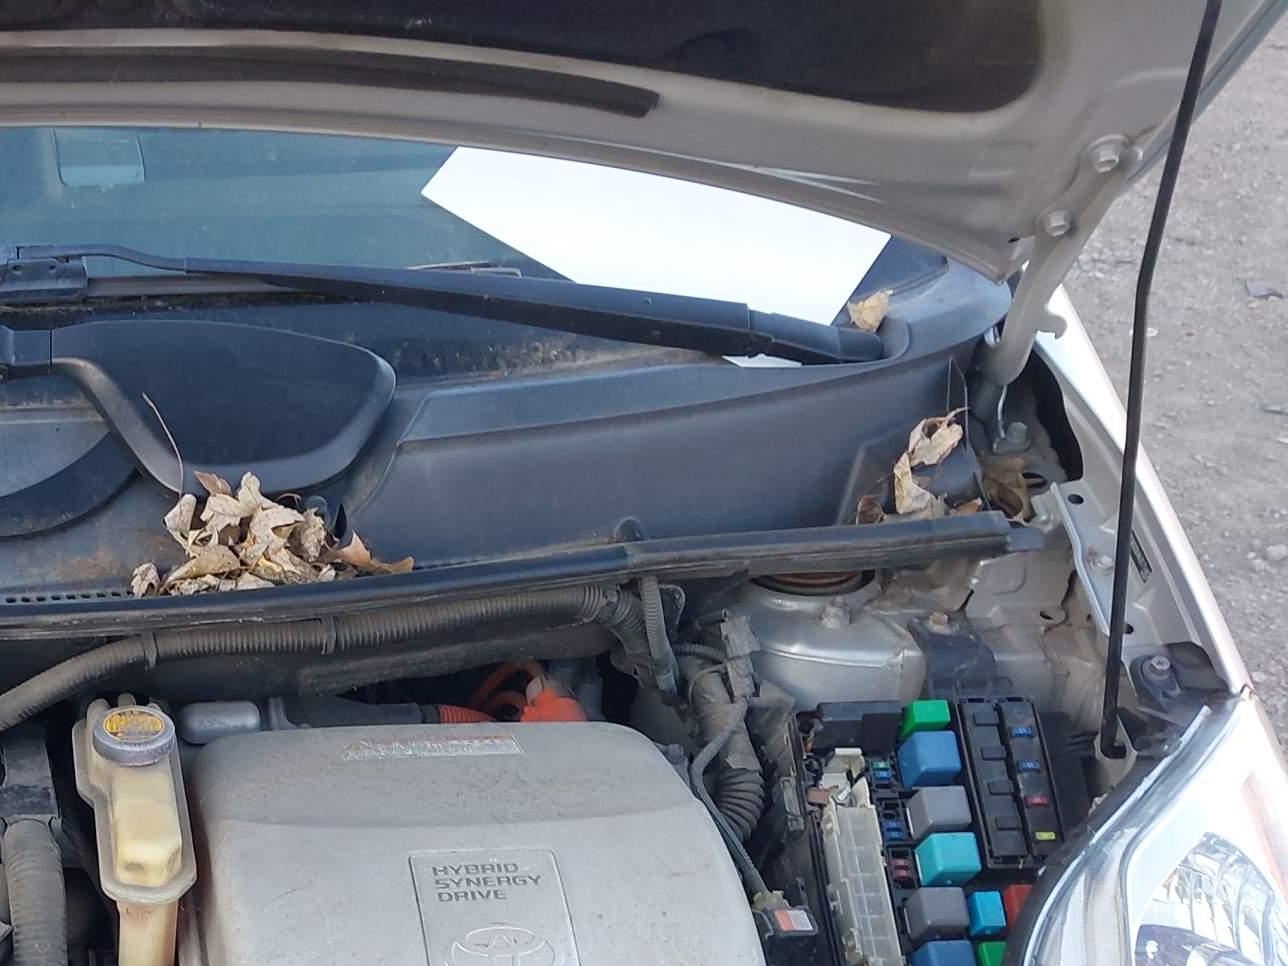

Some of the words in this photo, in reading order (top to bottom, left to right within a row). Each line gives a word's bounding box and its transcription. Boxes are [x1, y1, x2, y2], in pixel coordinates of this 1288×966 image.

[431, 863, 519, 876] HYBRID
[434, 875, 541, 889] SYNERGY
[437, 889, 508, 902] DRIVE
